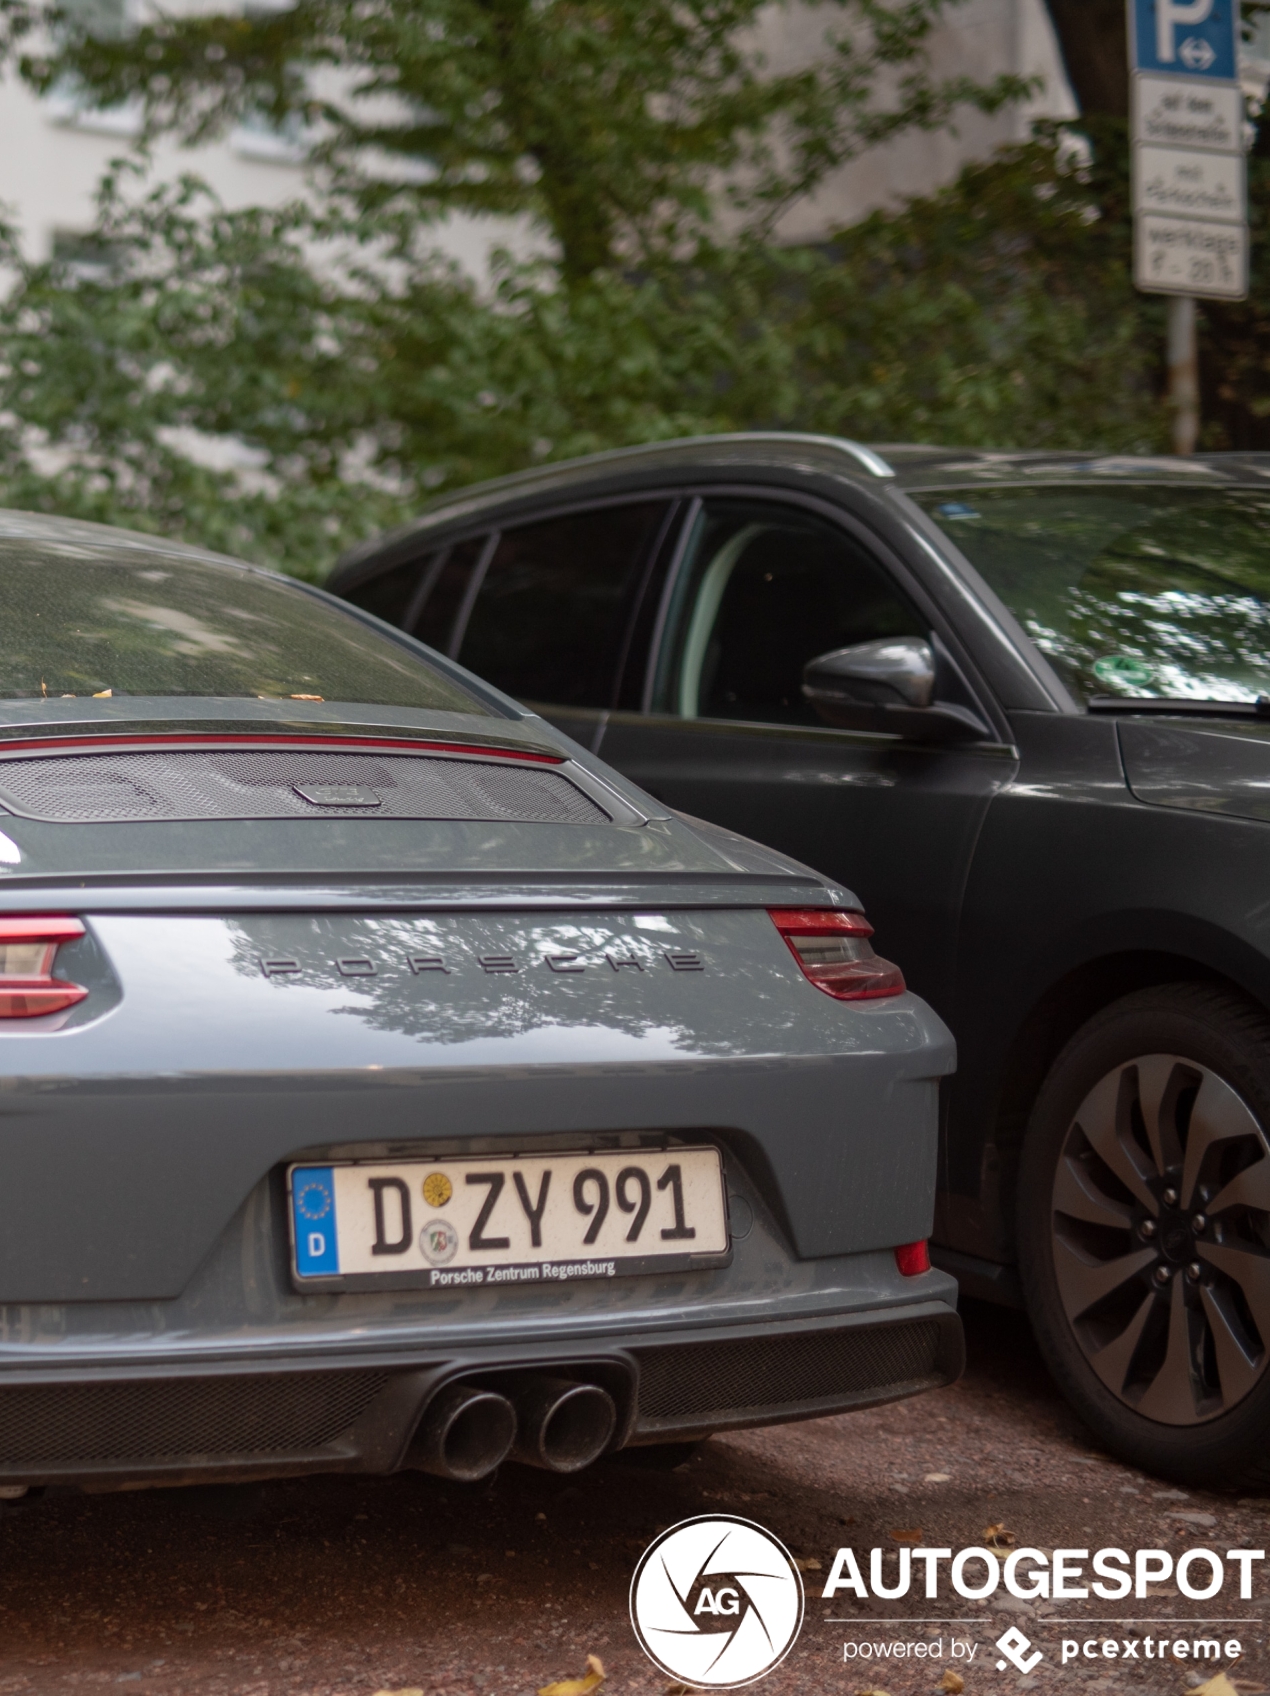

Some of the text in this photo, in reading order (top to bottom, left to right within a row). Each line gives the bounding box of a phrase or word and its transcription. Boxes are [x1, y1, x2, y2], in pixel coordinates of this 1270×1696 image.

[1156, 0, 1215, 63] P
[260, 953, 704, 977] PORSCHE
[368, 1176, 414, 1257] D
[465, 1170, 552, 1251] ZY
[572, 1164, 697, 1245] 991
[308, 1233, 326, 1257] D
[431, 1260, 616, 1285] Porsche Zentrum Regensburg
